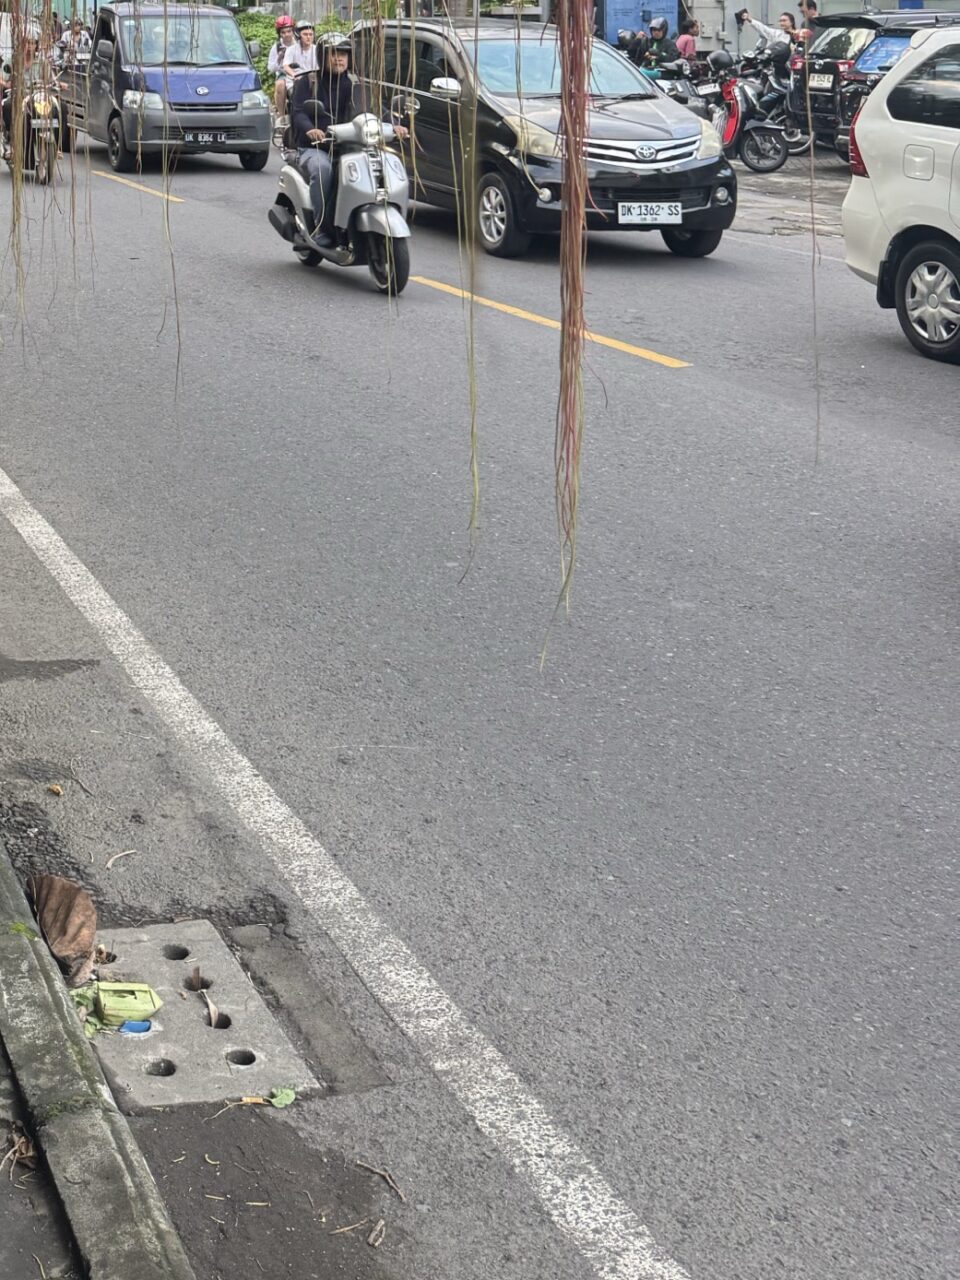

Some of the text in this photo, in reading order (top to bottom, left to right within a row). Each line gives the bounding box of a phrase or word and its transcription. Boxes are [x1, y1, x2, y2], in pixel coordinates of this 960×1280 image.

[621, 204, 680, 216] DK 1362 SS
